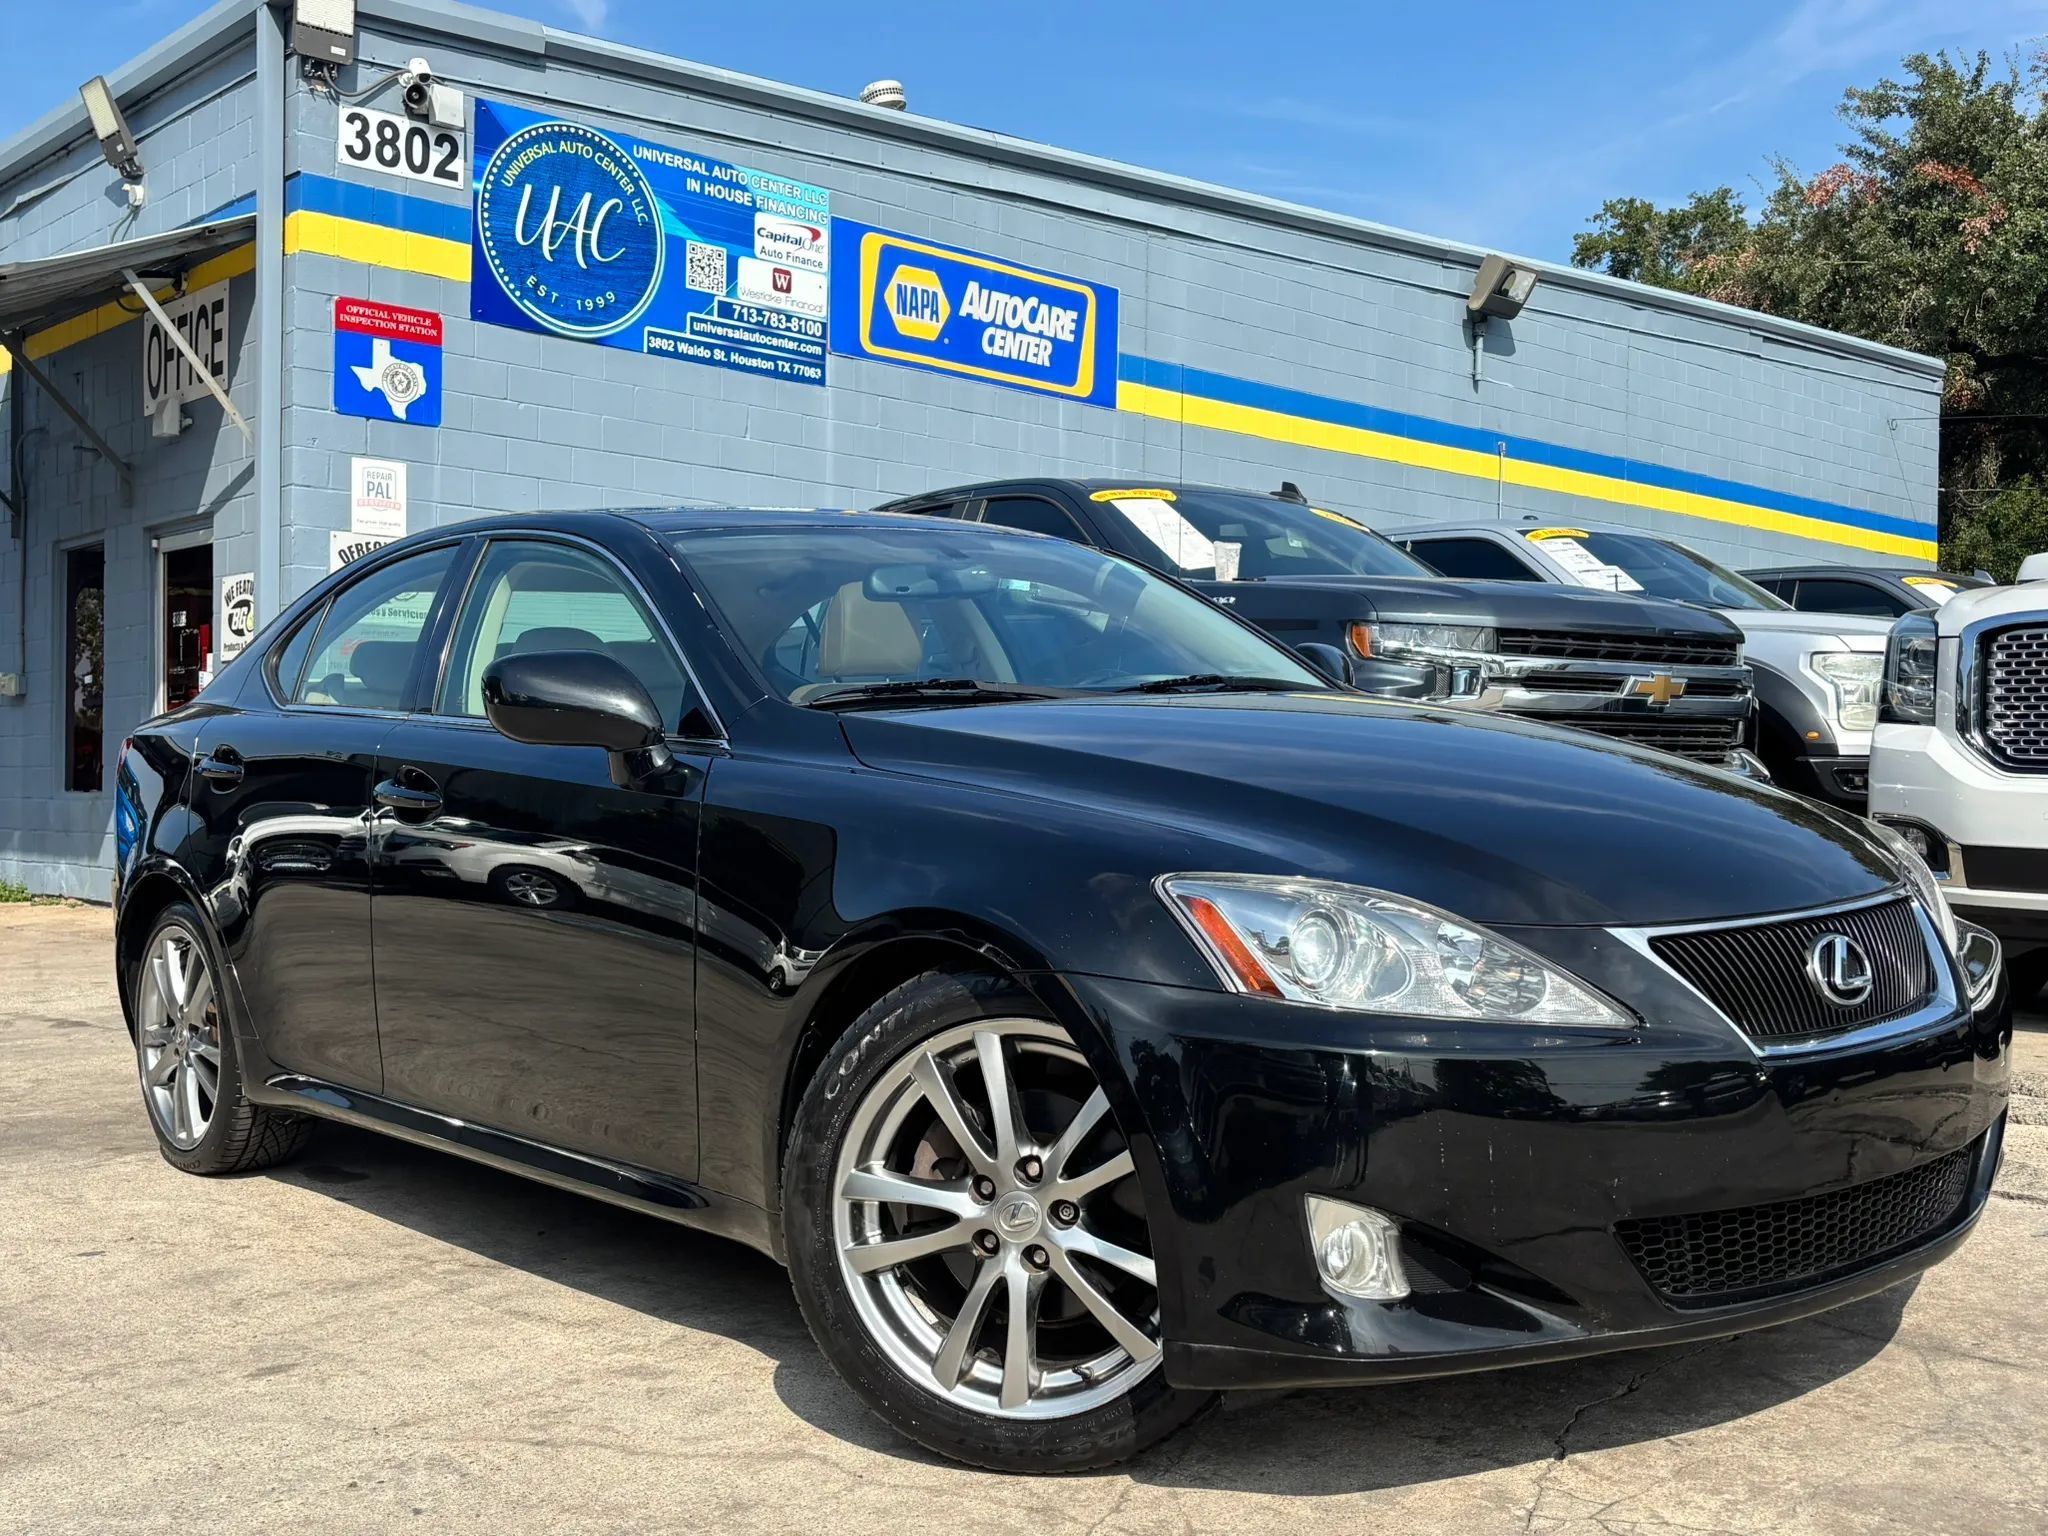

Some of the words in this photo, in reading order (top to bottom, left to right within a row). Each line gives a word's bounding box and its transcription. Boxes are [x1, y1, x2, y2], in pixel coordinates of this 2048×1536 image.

[345, 112, 459, 182] 3802
[500, 140, 557, 188] UNIVERSAL
[559, 140, 593, 159] AUTO
[594, 152, 635, 196] CENTER
[633, 144, 710, 176] UNIVERSAL
[711, 165, 749, 186] AUTO
[751, 175, 802, 199] CENTER
[804, 189, 828, 207] LLC
[686, 177, 700, 193] IN
[704, 181, 753, 207] HOUSE
[755, 196, 828, 225] FINANCING
[515, 183, 626, 270] UAC
[760, 245, 783, 260] Auto
[786, 251, 823, 269] Finance
[774, 272, 791, 290] W
[346, 304, 391, 320] OFFICIAL
[392, 312, 432, 327] VEHICLE
[576, 291, 615, 312] 1999
[740, 286, 782, 303] Westlake
[785, 295, 824, 313] Financial
[896, 283, 940, 323] NAPA
[340, 313, 397, 330] INSPECTION
[398, 323, 438, 336] STATION
[732, 304, 822, 337] 713-783-8100
[147, 298, 224, 400] OFFICE
[693, 321, 822, 356] universalautocenter.com
[981, 326, 1053, 368] CENTER
[649, 336, 675, 352] 3802
[676, 341, 711, 359] Waldo
[713, 349, 727, 362] St.
[730, 351, 775, 371] Houston
[776, 360, 791, 374] TX
[793, 363, 822, 379] 77063
[366, 470, 393, 481] REPAIR
[366, 480, 392, 500] PAL
[236, 580, 254, 596] FEATU
[231, 606, 249, 631] BG
